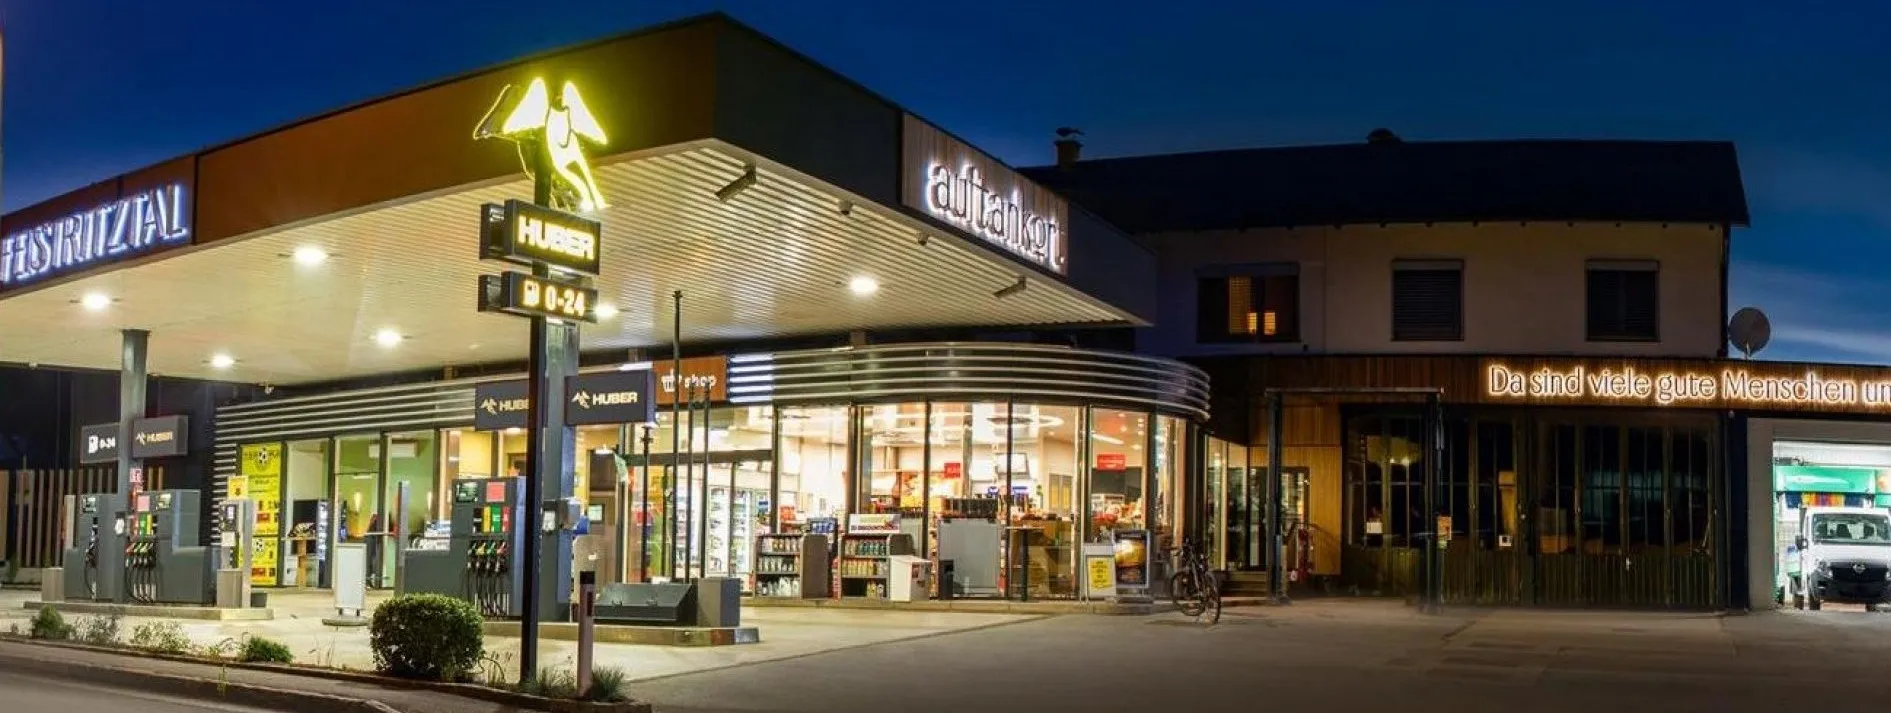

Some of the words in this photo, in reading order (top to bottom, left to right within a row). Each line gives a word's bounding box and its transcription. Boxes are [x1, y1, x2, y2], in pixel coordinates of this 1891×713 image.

[518, 214, 595, 260] HUBER
[544, 285, 585, 316] 0-24
[684, 374, 717, 390] shop
[1489, 365, 1526, 396] Da
[1530, 365, 1584, 397] sind
[1588, 365, 1651, 399] viele
[1656, 371, 1715, 405] gute
[1723, 370, 1857, 404] Menschen
[592, 391, 638, 405] HUBER
